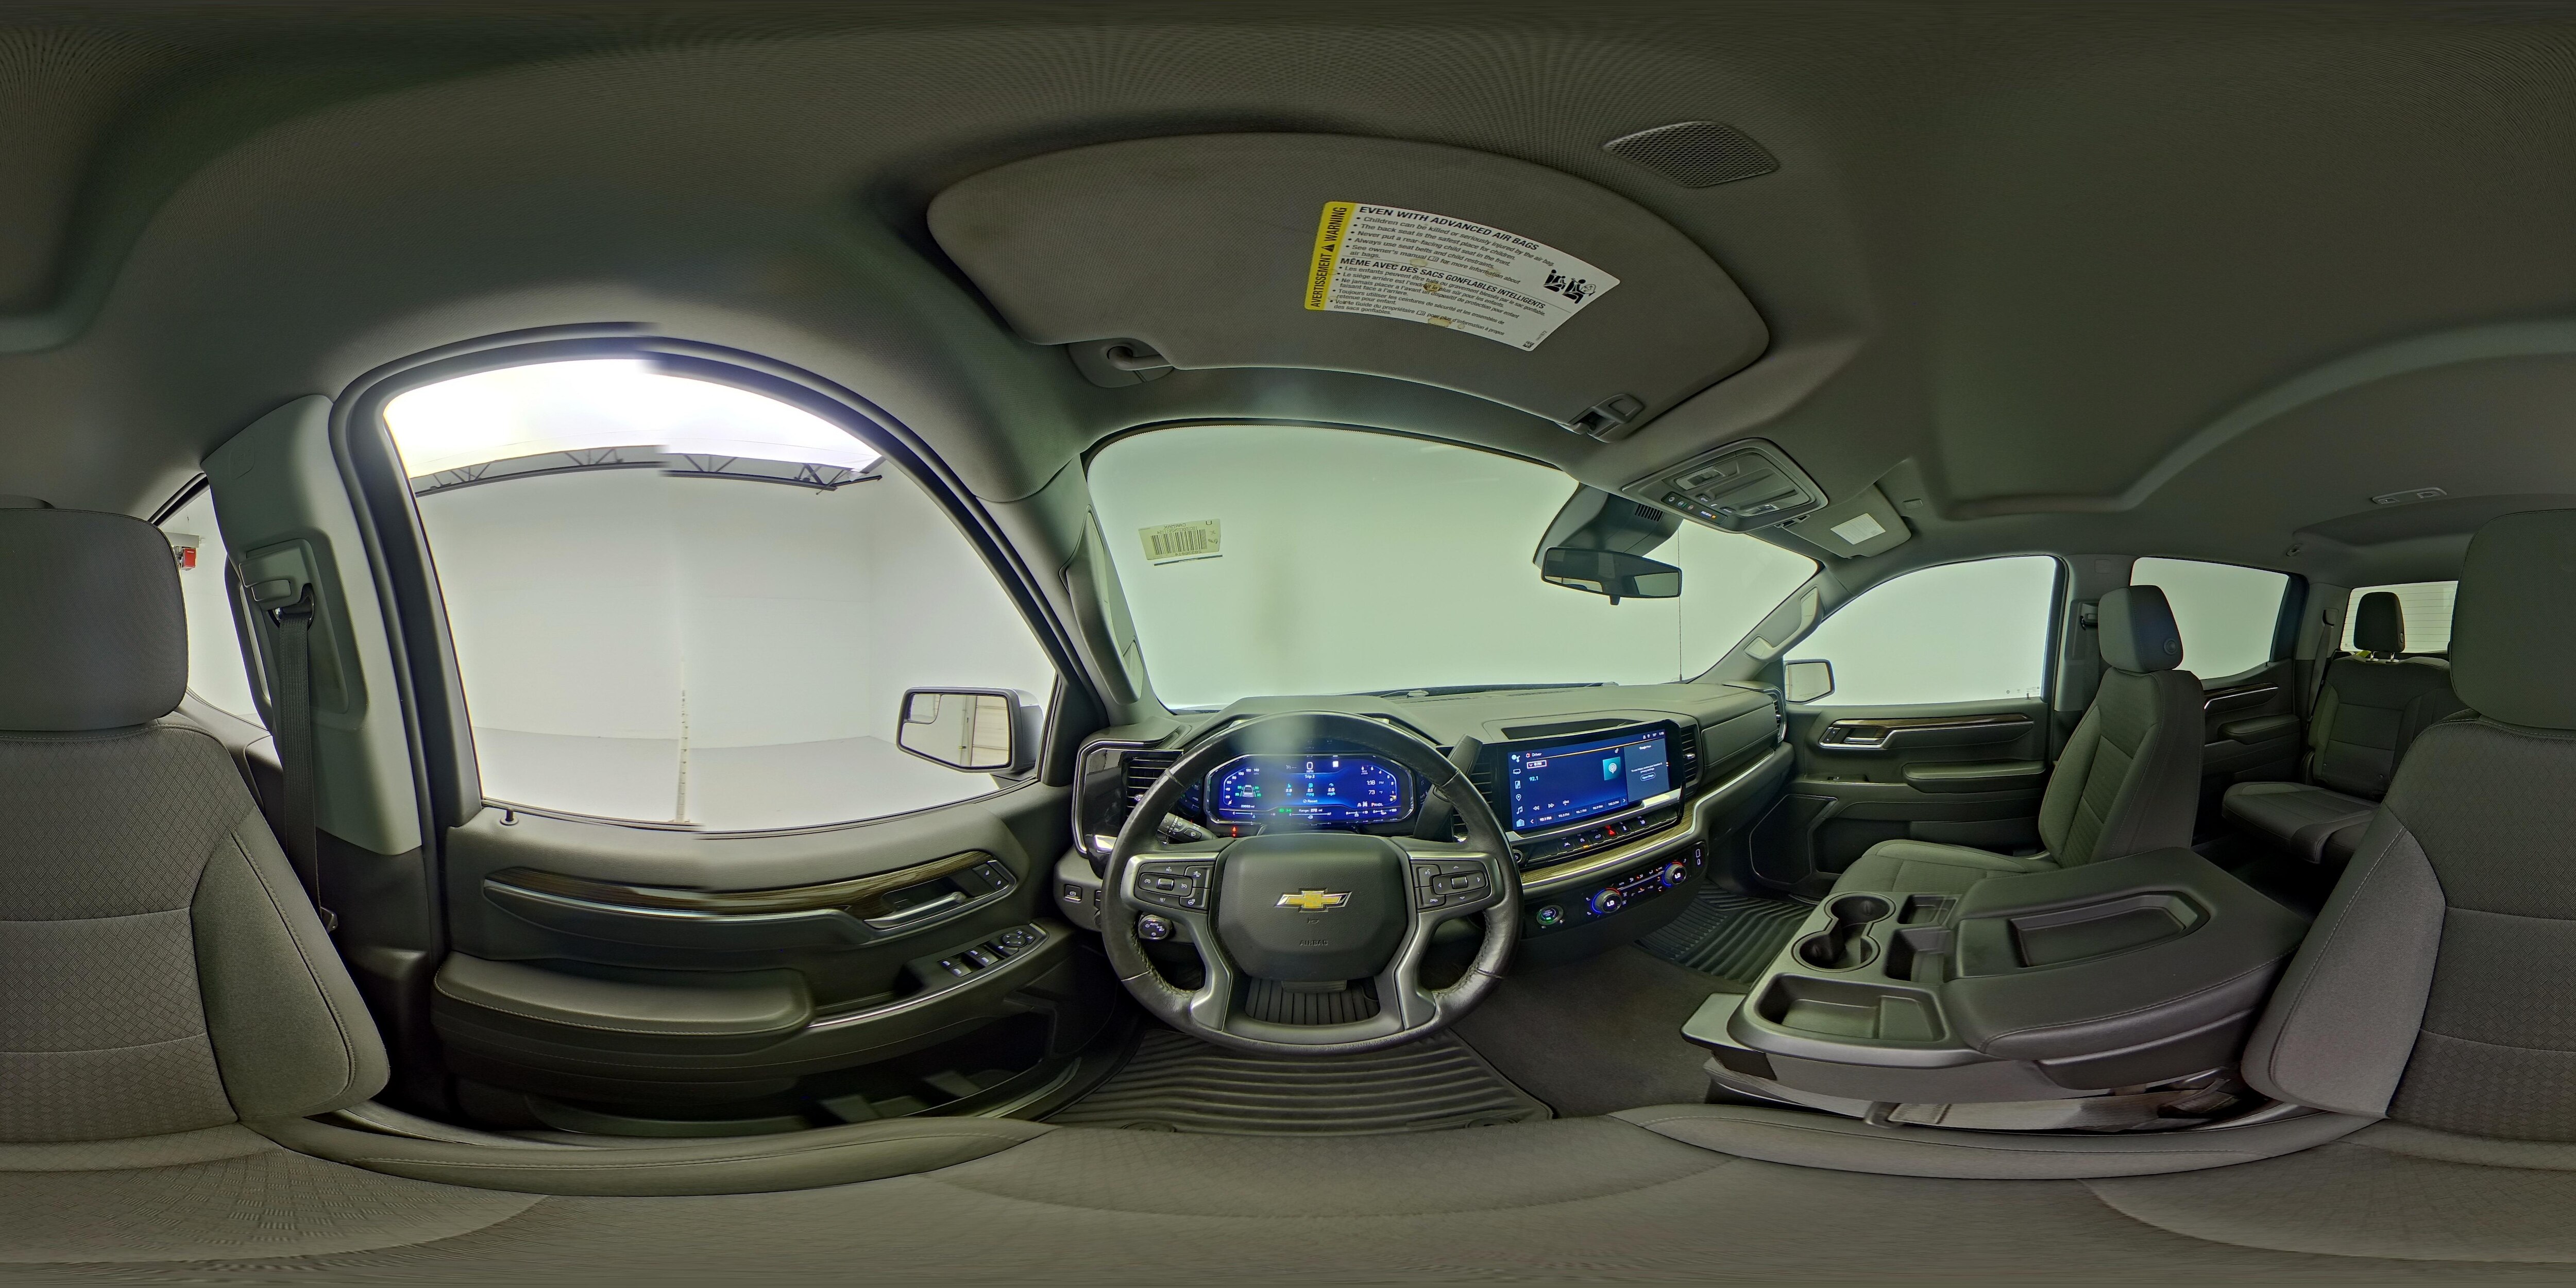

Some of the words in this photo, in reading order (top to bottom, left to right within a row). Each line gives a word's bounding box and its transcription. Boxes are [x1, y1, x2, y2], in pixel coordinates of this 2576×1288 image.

[1360, 207, 1394, 215] EVEN
[1397, 211, 1429, 222] WITH
[1430, 217, 1492, 235] ADVANCED
[1493, 232, 1512, 241] AIR
[1512, 238, 1539, 250] BAGS
[1364, 217, 1398, 226] Children
[1428, 227, 1449, 235] killed
[1460, 234, 1492, 245] seriously
[1492, 242, 1515, 252] injured
[1311, 253, 1332, 307] AVERTISSEMENT
[1325, 207, 1347, 241] WARNING
[1403, 237, 1443, 249] rear-facing
[1495, 258, 1511, 266] front.
[1438, 236, 1460, 245] safest
[1460, 240, 1479, 249] place
[1490, 249, 1515, 260] children.
[1465, 258, 1494, 268] restraints.
[1400, 251, 1427, 260] manual
[1469, 266, 1503, 280] information
[1503, 276, 1521, 284] about
[1340, 258, 1371, 266] MÊME
[1372, 262, 1398, 270] AVEC
[1420, 269, 1444, 279] SACS
[1446, 275, 1496, 293] GONFLABLES
[1497, 289, 1546, 309] INTELLIGENTS
[1449, 283, 1479, 295] gravement
[1479, 291, 1500, 300] blessés
[1399, 296, 1426, 304] ceintures
[1434, 302, 1457, 312] sécurité
[1471, 313, 1498, 323] ensembles
[1401, 284, 1421, 293] l'avant
[1431, 290, 1458, 300] dispositif
[1465, 299, 1491, 310] protection
[1503, 310, 1520, 319] enfant
[1484, 298, 1504, 308] enfants.
[1382, 306, 1415, 314] propriétaire
[1452, 318, 1484, 330] d'information
[1488, 328, 1505, 336] propos
